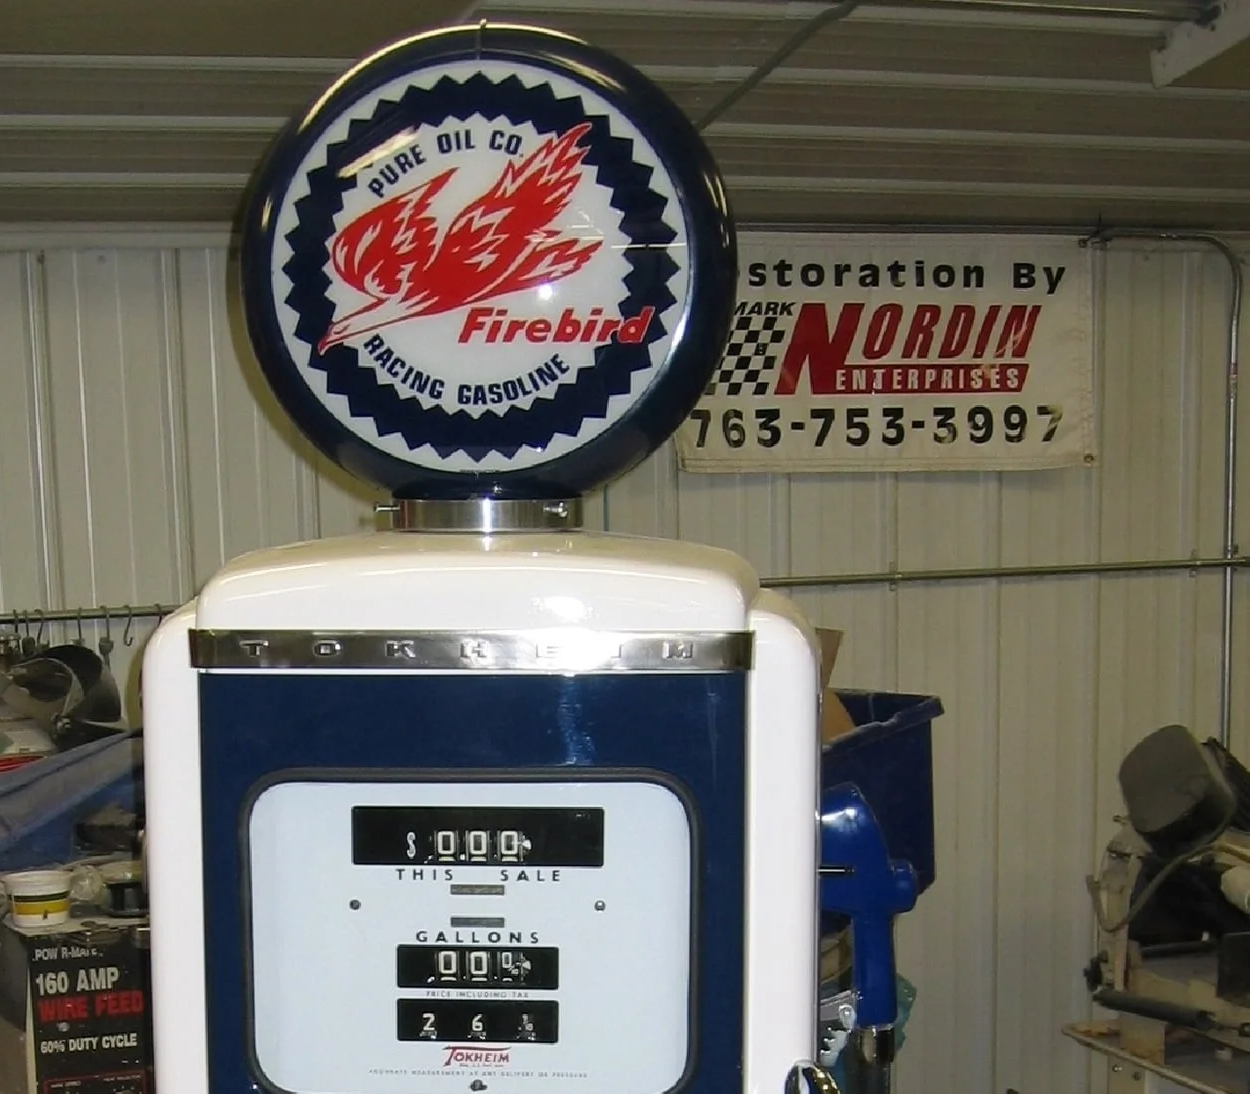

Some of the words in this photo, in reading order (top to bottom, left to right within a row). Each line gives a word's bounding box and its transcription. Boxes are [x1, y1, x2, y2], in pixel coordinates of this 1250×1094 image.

[368, 144, 426, 198] PURE
[436, 129, 476, 154] OIL
[489, 130, 524, 158] CO.
[747, 260, 986, 288] storation
[1013, 262, 1066, 295] By
[458, 306, 656, 343] Firebird
[773, 302, 1043, 396] NORDIN
[363, 333, 445, 400] RACING
[457, 353, 570, 406] GASOLINE
[834, 368, 1020, 392] ENTERPRISES
[690, 404, 1064, 449] 763-753-3997
[396, 869, 453, 881] THIS
[500, 869, 561, 881] SALE
[415, 931, 540, 944] GALLONS
[35, 971, 69, 996] 160
[76, 967, 120, 992] AMP
[38, 996, 88, 1023] WIRE
[95, 990, 144, 1017] FEED
[422, 1013, 436, 1031] 2
[471, 1014, 483, 1031] 6
[40, 1039, 66, 1054] 60%
[69, 1036, 99, 1052] DUTY
[102, 1033, 138, 1049] CYCLE
[442, 1046, 512, 1067] TOKHEIM
